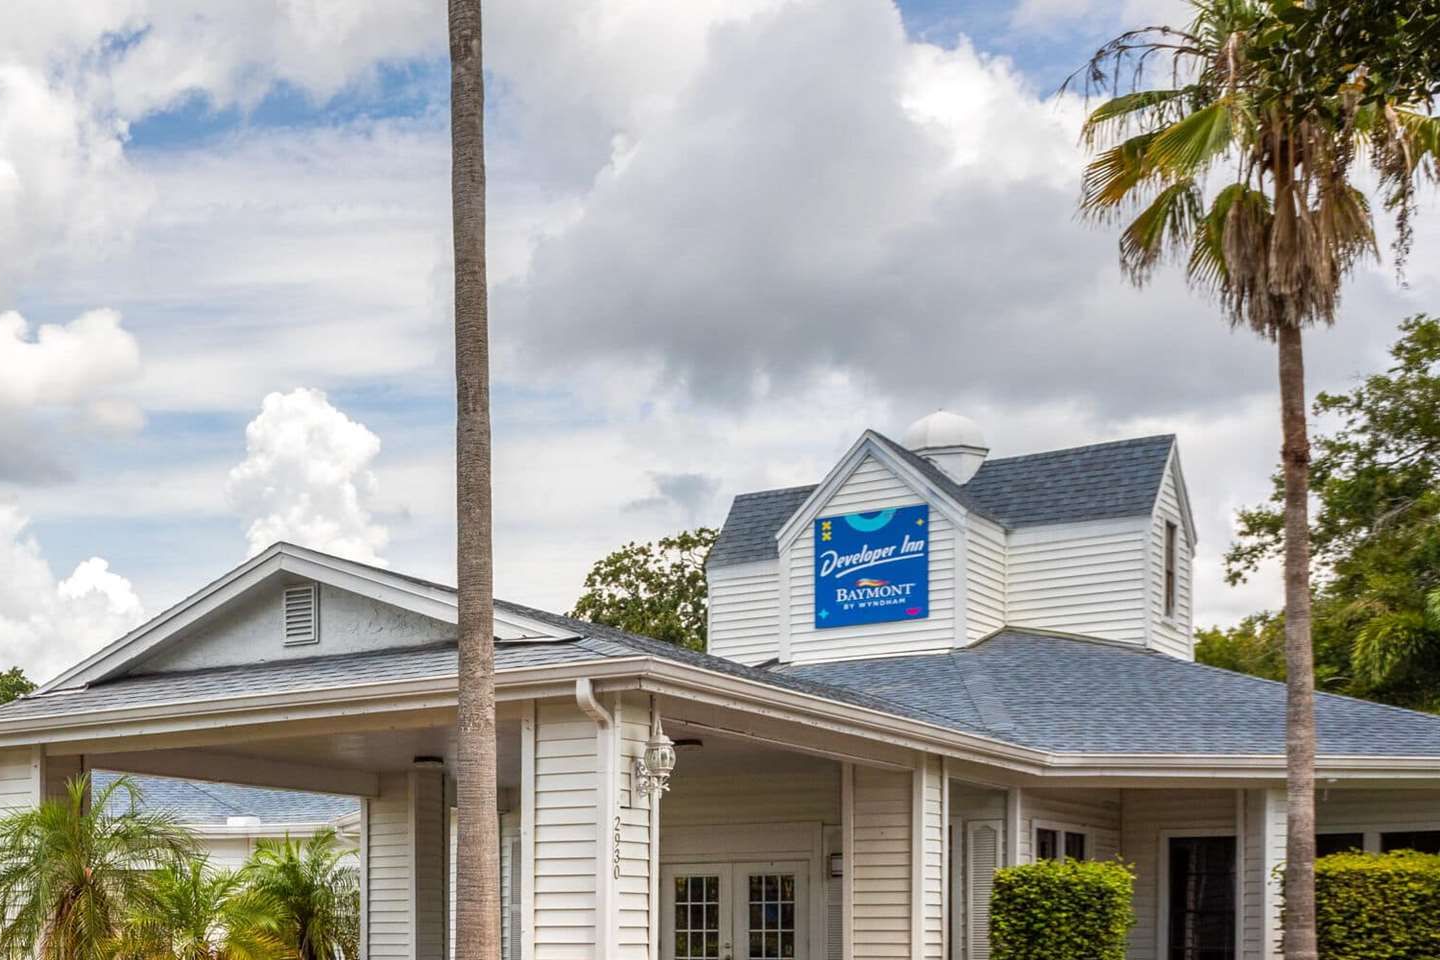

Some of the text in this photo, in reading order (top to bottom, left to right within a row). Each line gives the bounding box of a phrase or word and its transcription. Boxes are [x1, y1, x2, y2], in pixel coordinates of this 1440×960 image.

[820, 534, 925, 577] Developer Inn
[836, 583, 916, 602] BAYMONT
[858, 598, 906, 608] WYNDHAM
[613, 816, 621, 880] 2930
